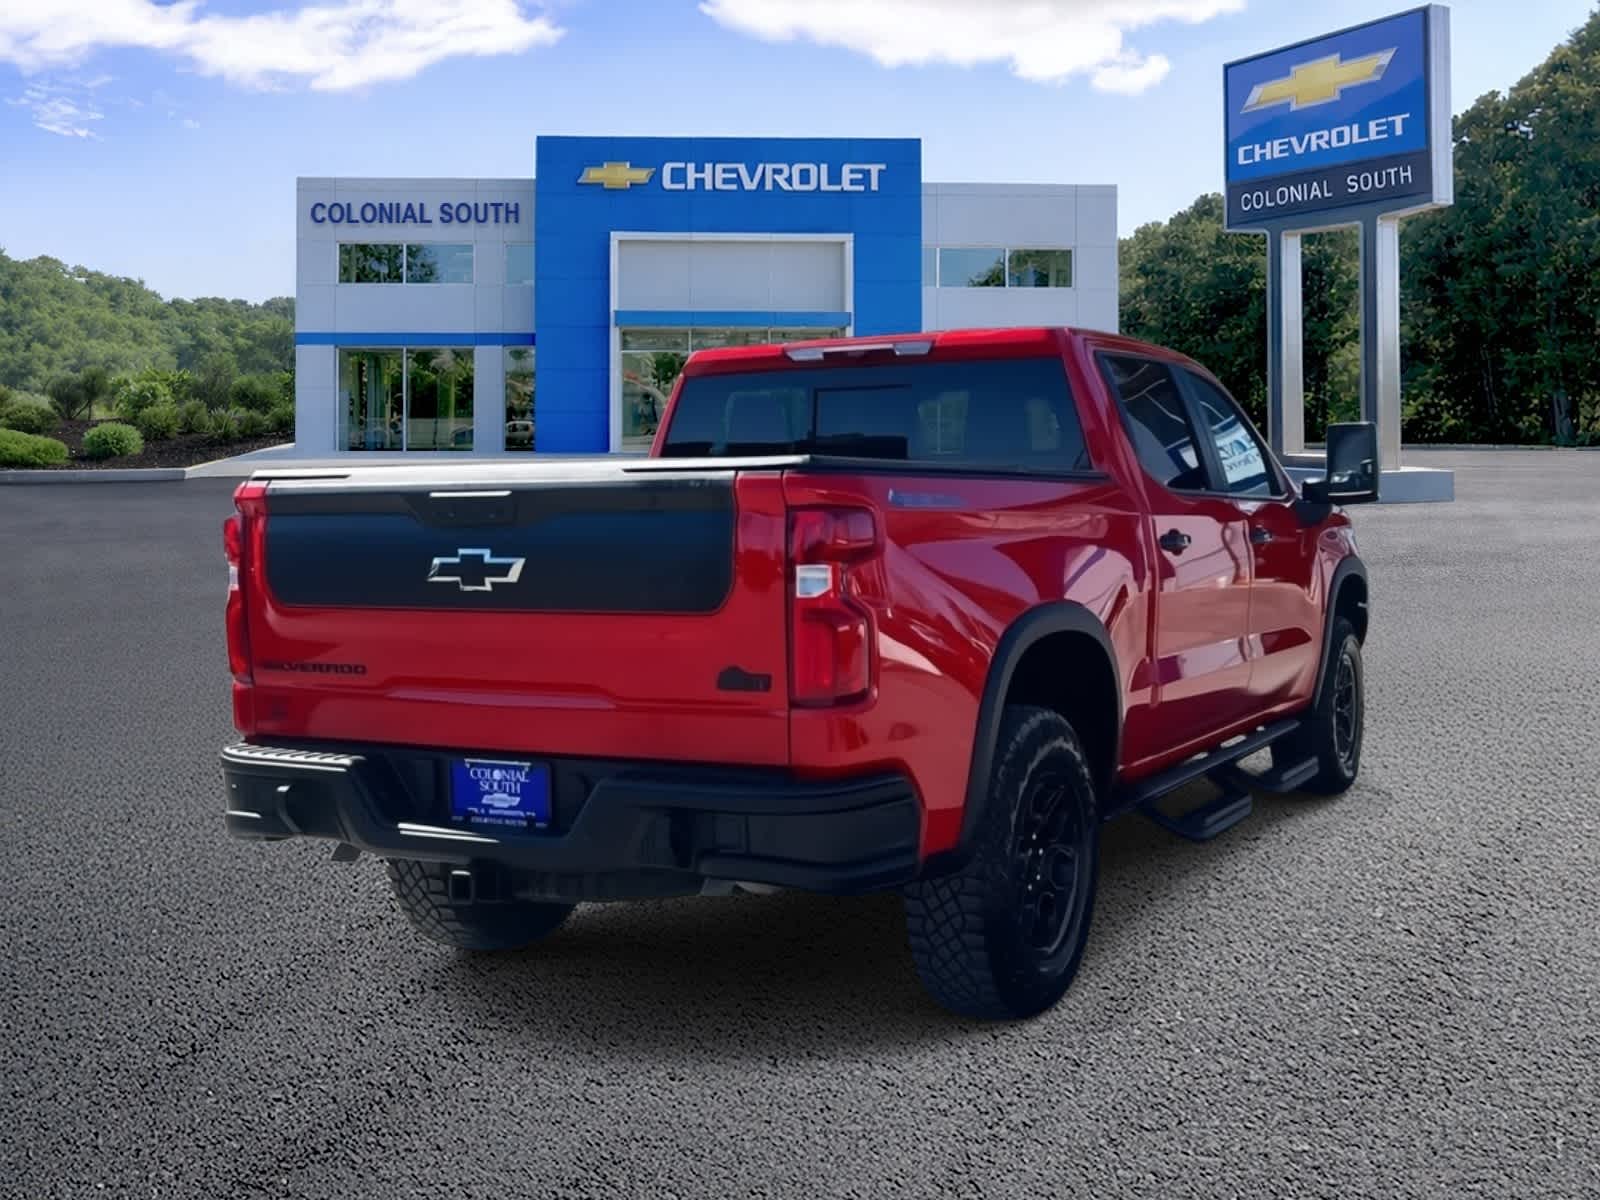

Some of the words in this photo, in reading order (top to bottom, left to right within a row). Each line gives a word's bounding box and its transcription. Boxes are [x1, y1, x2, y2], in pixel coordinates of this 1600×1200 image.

[1237, 113, 1410, 165] CHEVROLET
[661, 161, 887, 192] CHEVROLET
[1240, 180, 1333, 211] COLONIAL
[1346, 165, 1413, 193] SOUTH
[310, 202, 433, 224] COLONIAL
[439, 202, 520, 224] SOUTH
[261, 661, 368, 675] LVERADO
[470, 767, 530, 783] COLONIAL
[479, 780, 521, 794] SOUTH
